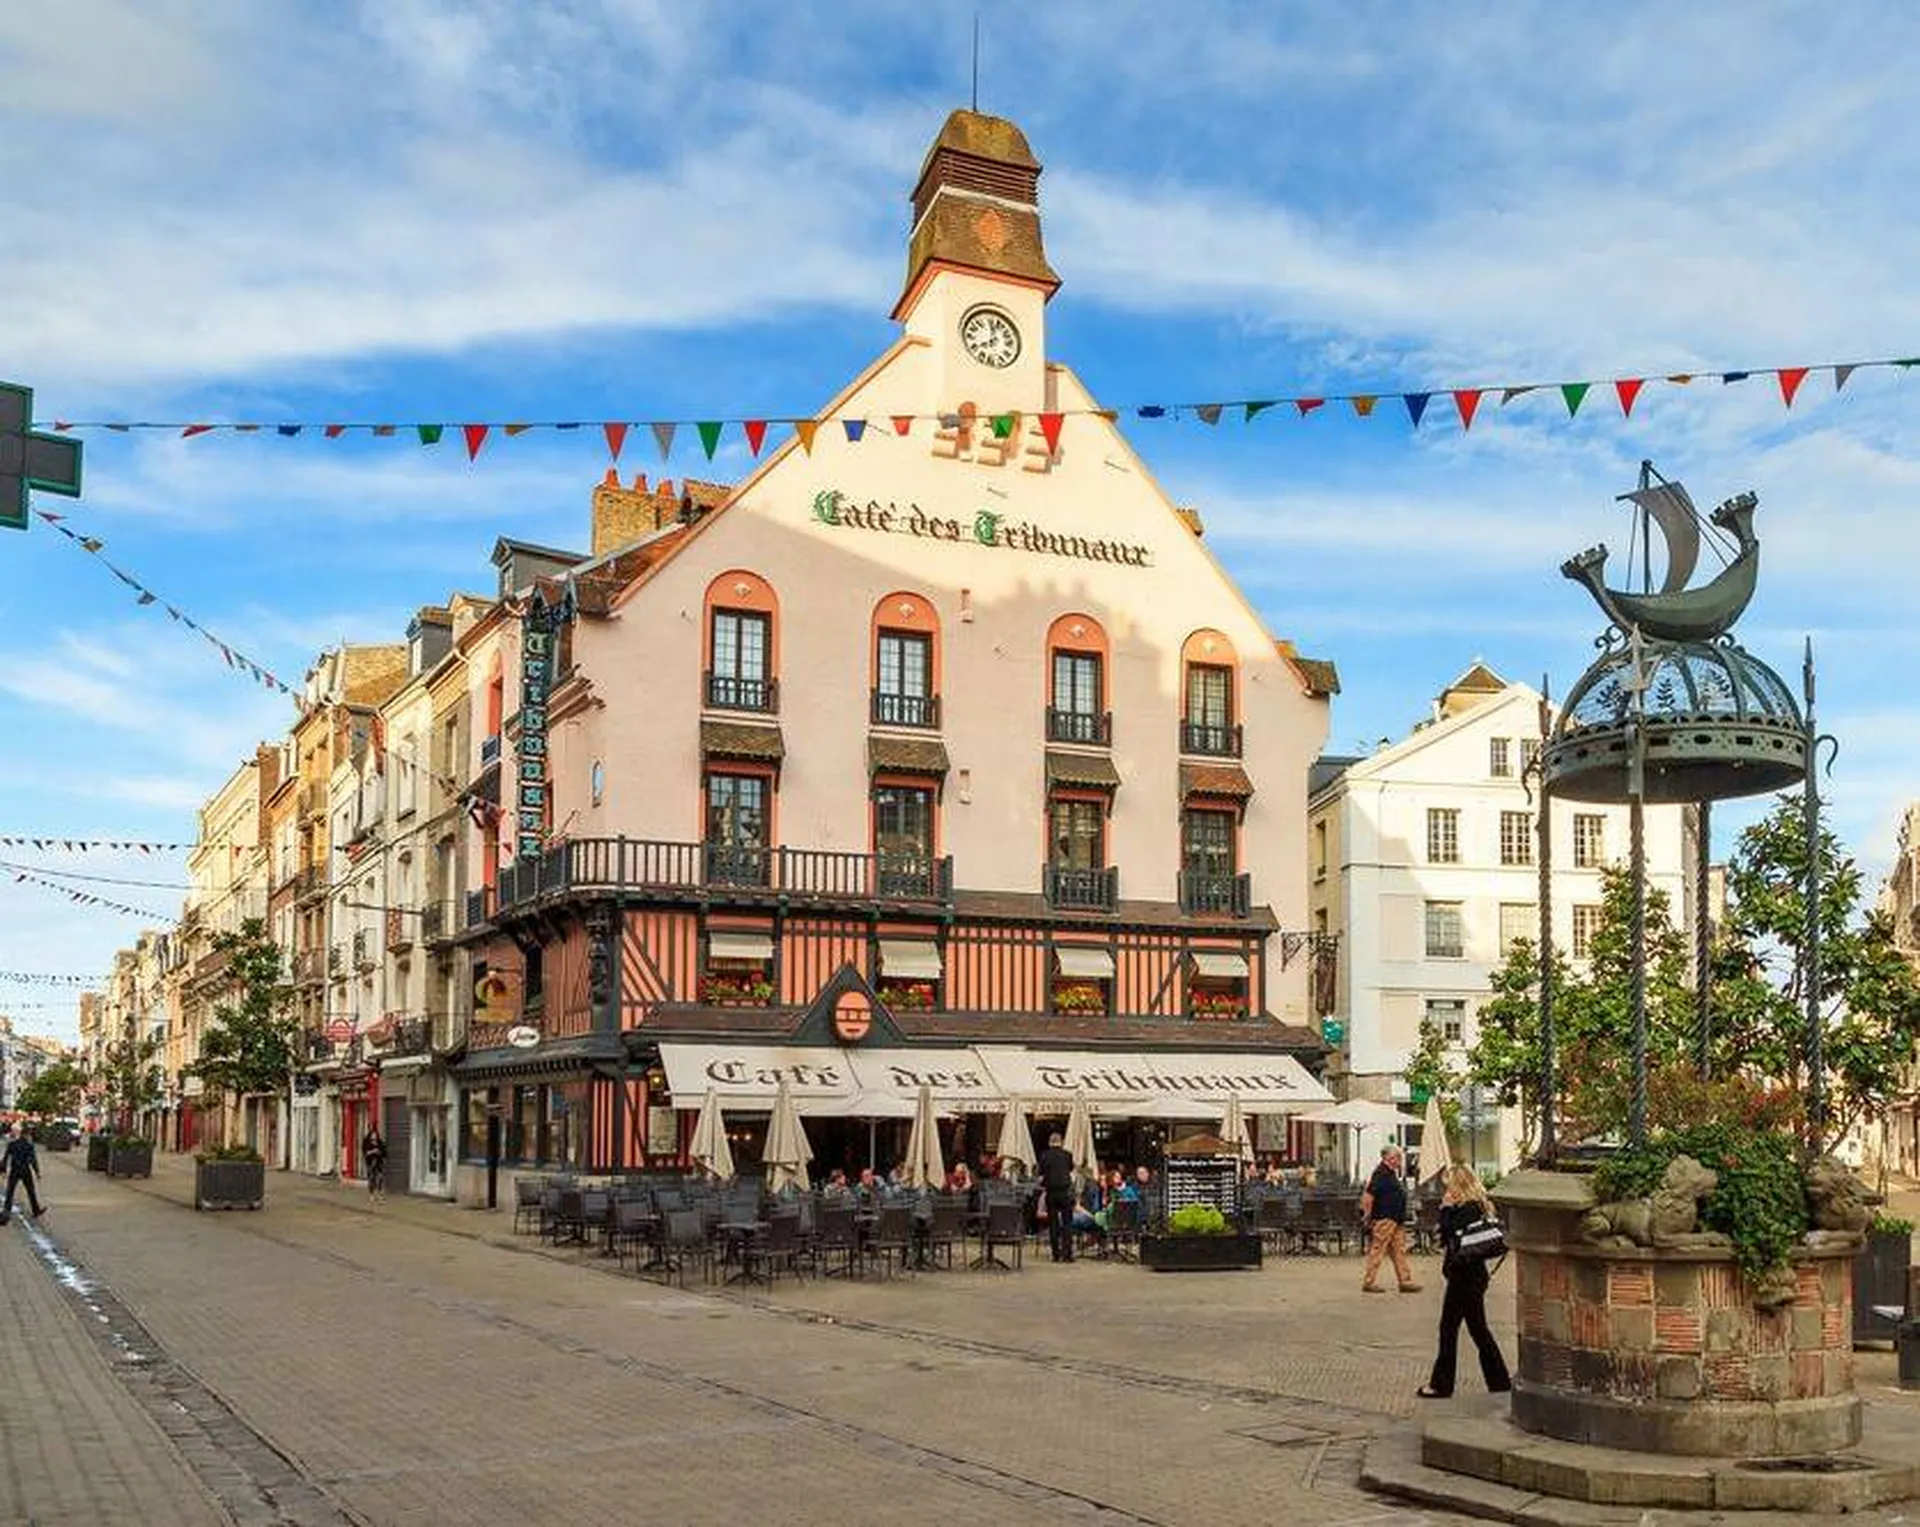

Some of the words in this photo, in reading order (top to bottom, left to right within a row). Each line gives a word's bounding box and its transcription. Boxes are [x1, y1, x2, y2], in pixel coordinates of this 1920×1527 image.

[814, 490, 896, 532] Café
[909, 503, 961, 541] des
[973, 510, 1153, 567] Tribunaux
[706, 1059, 841, 1087] Café
[889, 1064, 983, 1089] des
[1036, 1065, 1297, 1091] Tribunaux
